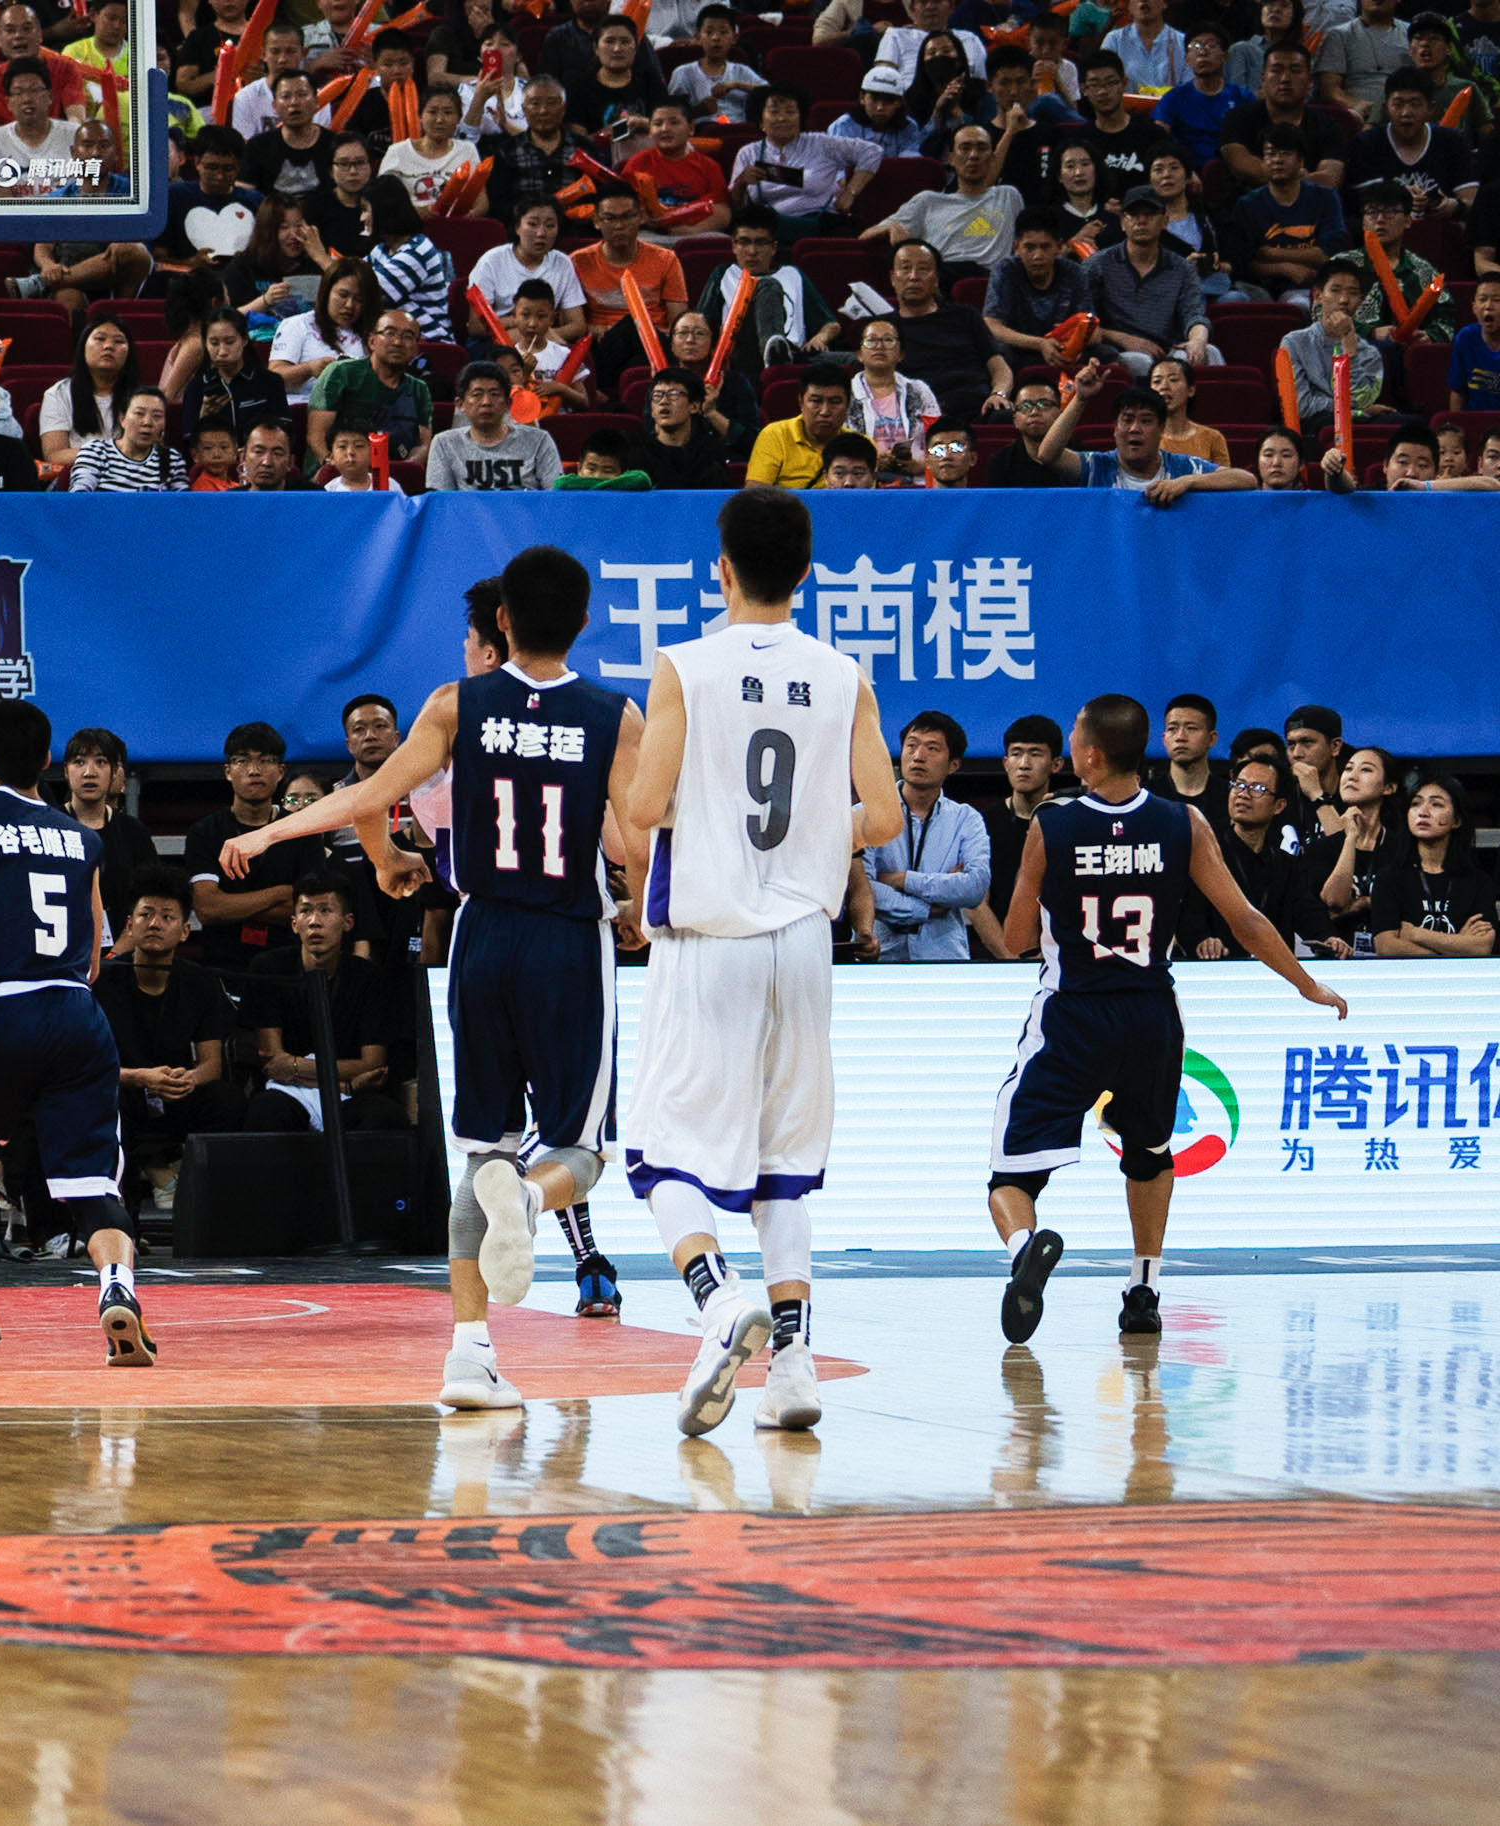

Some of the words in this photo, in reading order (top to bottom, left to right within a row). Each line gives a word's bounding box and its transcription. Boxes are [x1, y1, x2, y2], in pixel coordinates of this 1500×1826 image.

[27, 158, 102, 178] 腾讯体育
[465, 459, 524, 490] JUST
[599, 553, 1035, 684] 王南模
[493, 777, 566, 878] 11
[746, 728, 796, 852] 9
[28, 871, 68, 958] 5
[1081, 893, 1155, 968] 13
